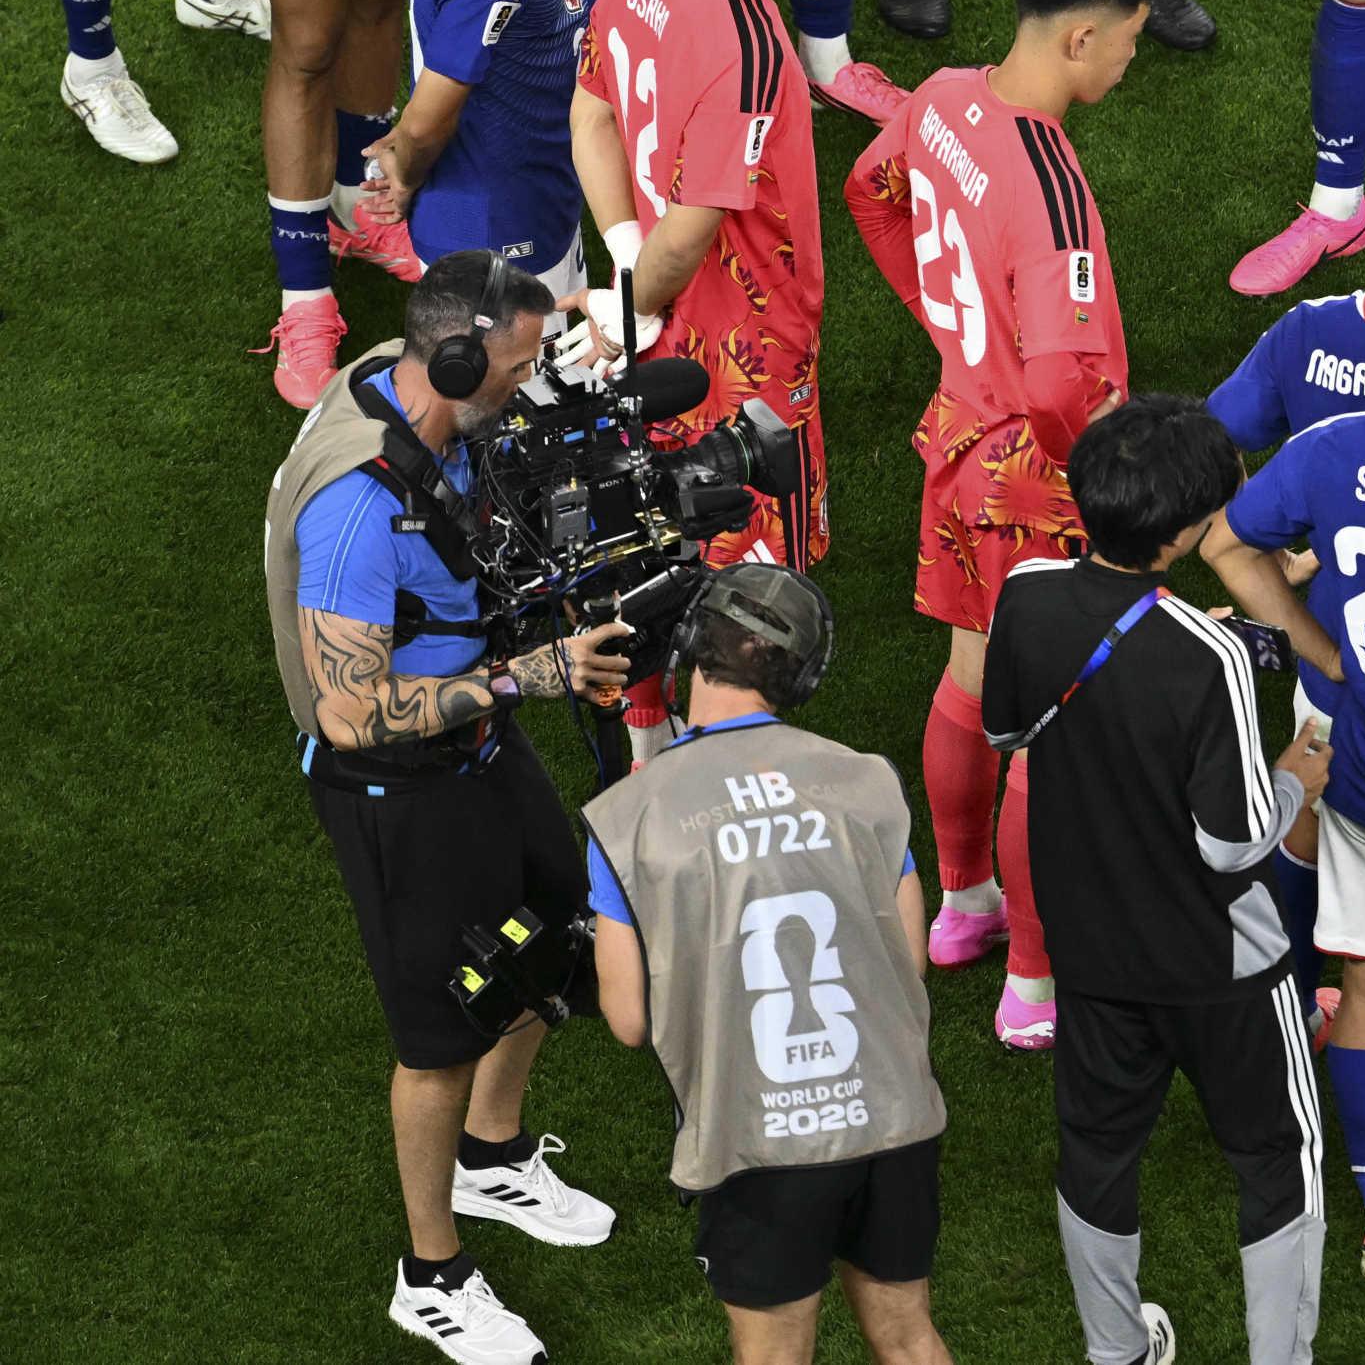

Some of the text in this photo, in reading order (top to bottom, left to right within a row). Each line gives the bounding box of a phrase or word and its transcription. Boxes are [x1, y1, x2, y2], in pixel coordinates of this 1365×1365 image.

[607, 26, 668, 219] 12
[918, 102, 990, 208] HAYAKAWA
[908, 167, 987, 368] 23
[724, 771, 797, 813] HB
[716, 809, 832, 865] 0722
[785, 1039, 837, 1065] FIFA
[761, 1078, 864, 1109] WORLD CUP
[764, 1099, 869, 1138] 2026
